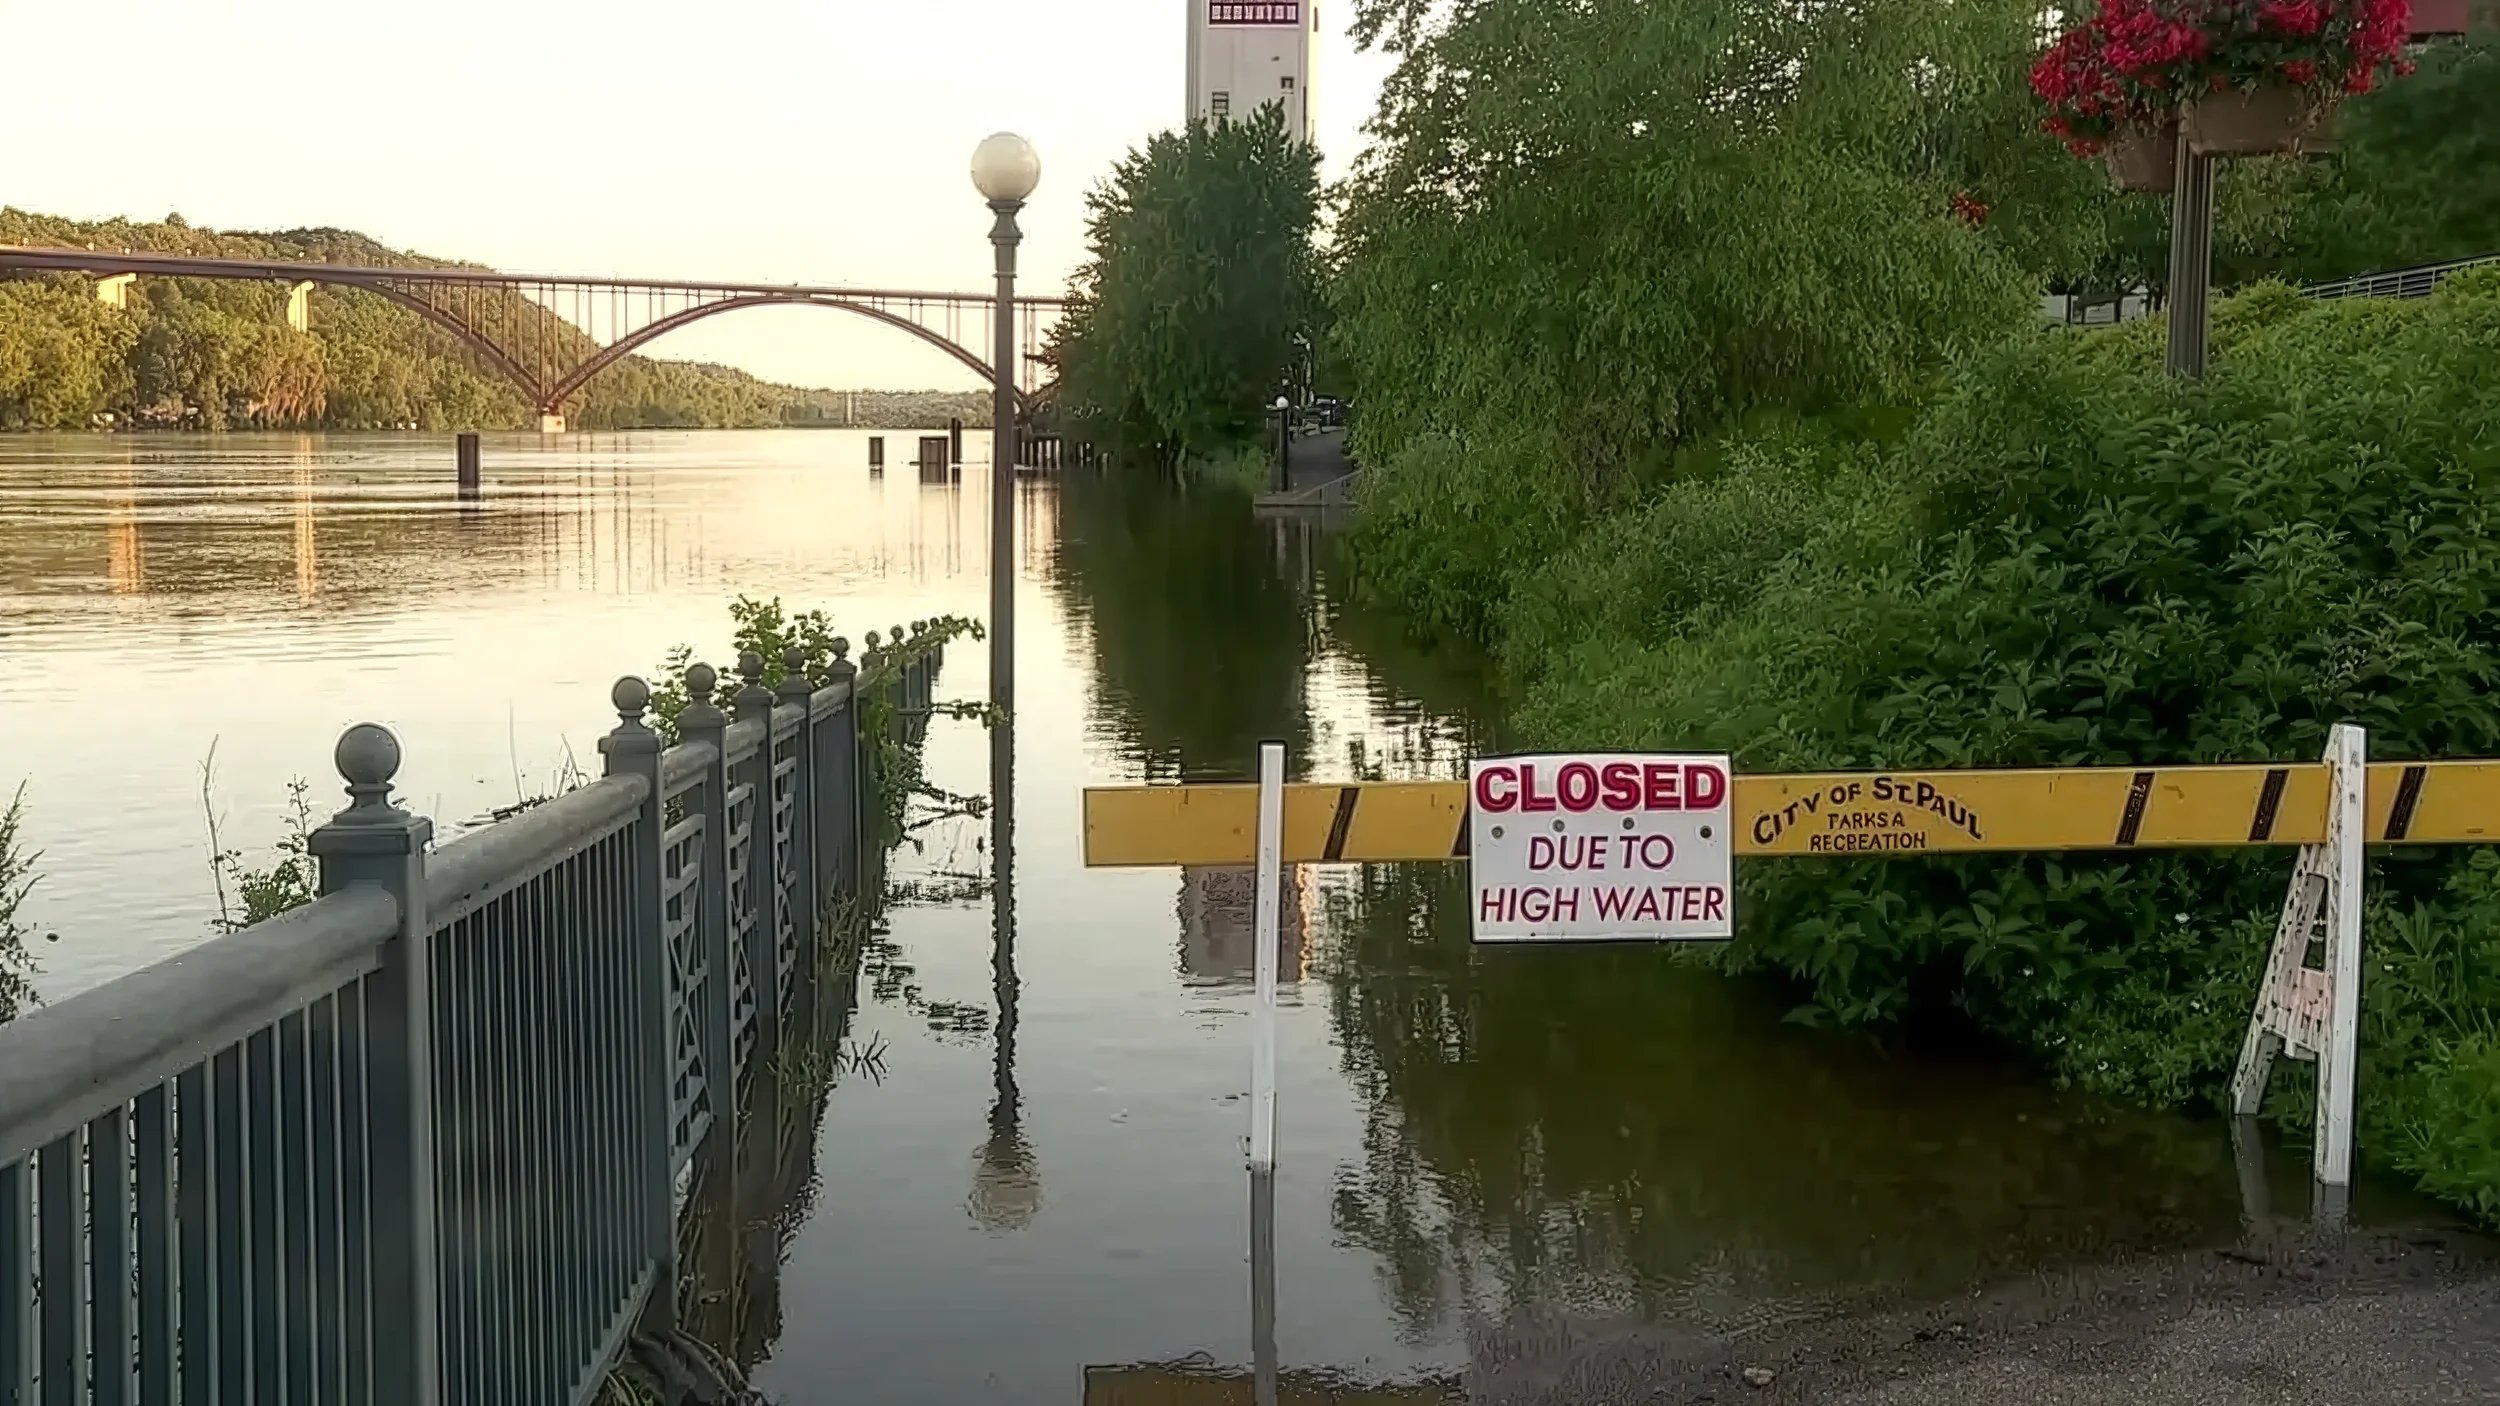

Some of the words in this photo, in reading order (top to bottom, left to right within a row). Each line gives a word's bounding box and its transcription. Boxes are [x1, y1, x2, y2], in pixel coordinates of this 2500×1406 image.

[1476, 762, 1726, 812] CLOSED
[1753, 792, 1820, 845] CITY
[1829, 783, 1861, 805] OF
[1916, 781, 1982, 840] PAUL
[1827, 812, 1888, 830] PARKS
[1529, 836, 1608, 870] DUE
[1619, 835, 1674, 869] TO
[1810, 831, 1926, 852] RECREATION
[1480, 888, 1580, 922] HIGH
[1593, 886, 1724, 921] WATER
